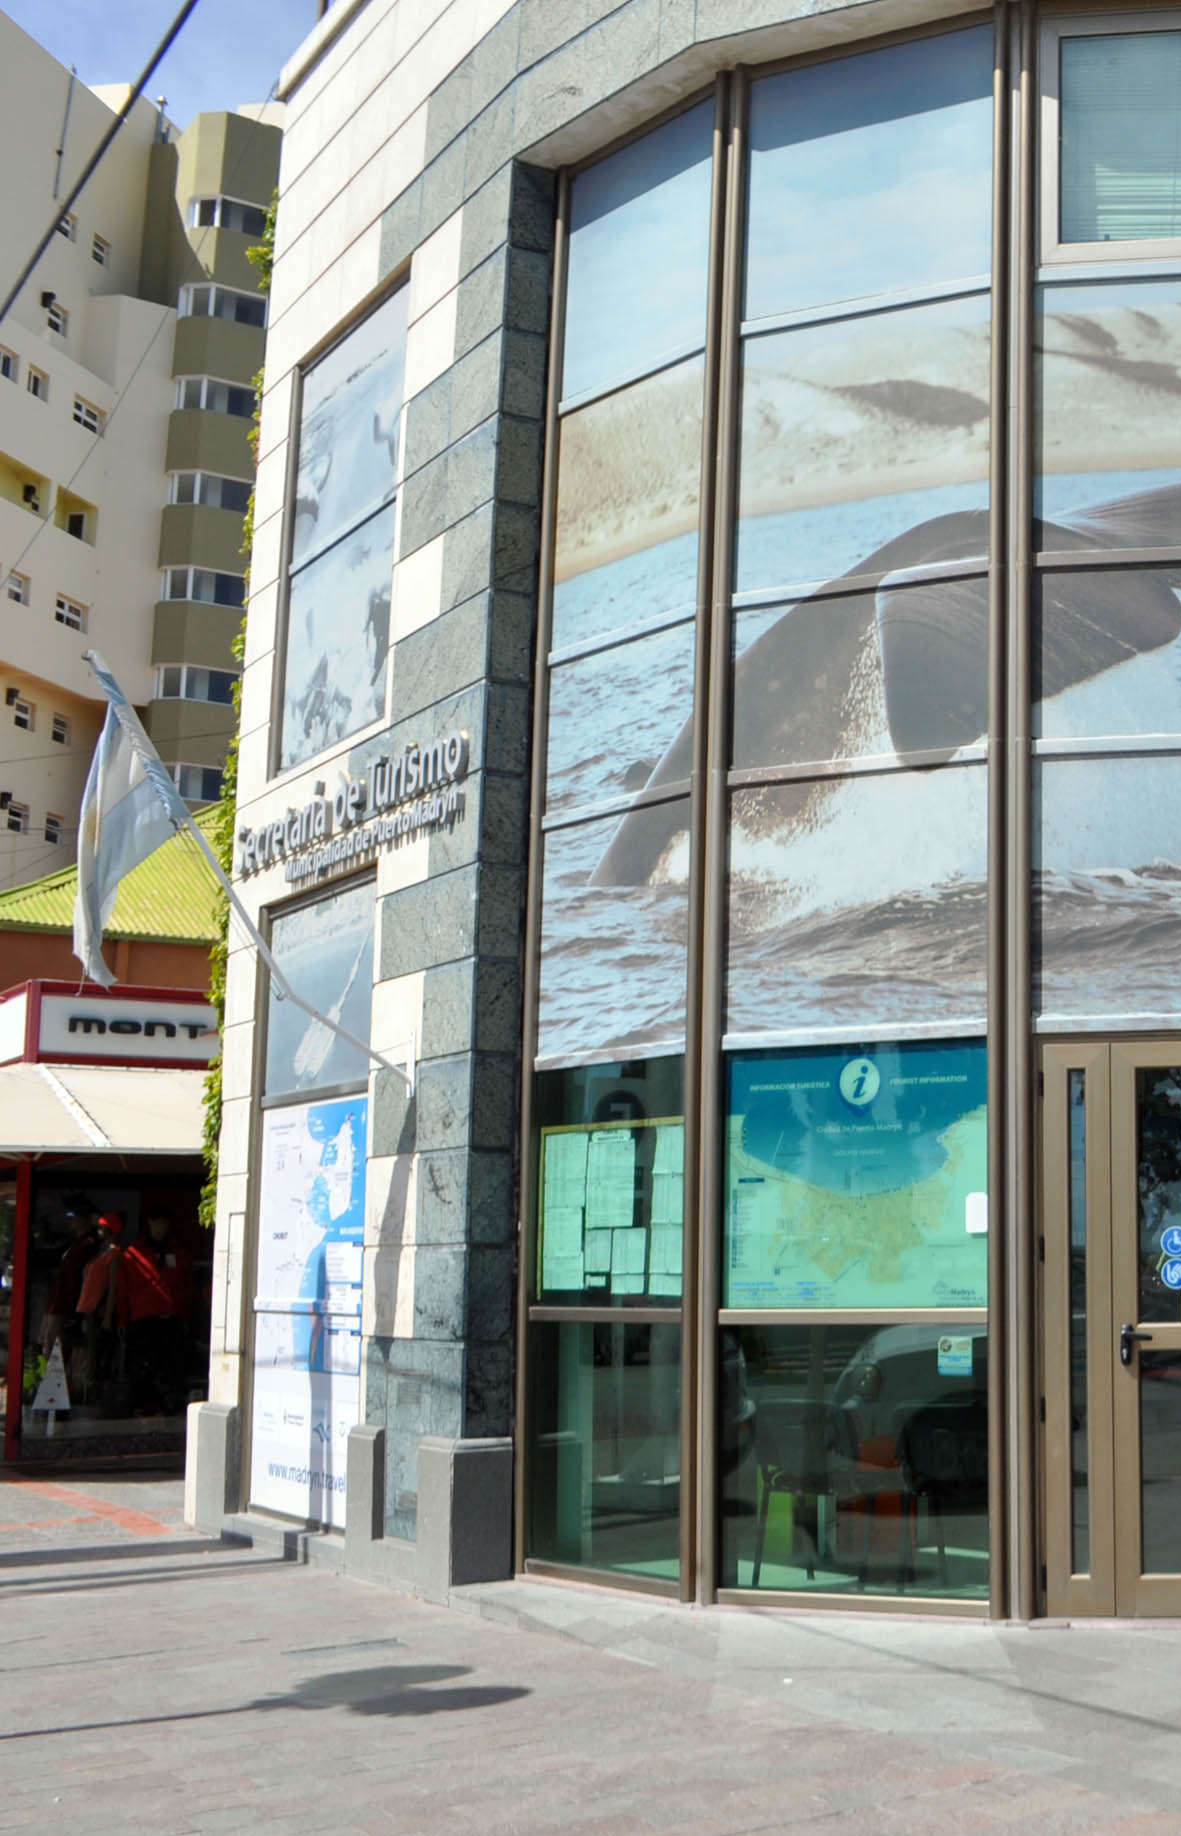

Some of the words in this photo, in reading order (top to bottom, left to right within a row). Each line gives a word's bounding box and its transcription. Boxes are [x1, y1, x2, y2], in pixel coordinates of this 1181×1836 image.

[333, 770, 360, 829] de
[367, 730, 463, 817] Turismo
[284, 834, 355, 881] Municipalidad
[355, 831, 371, 853] de
[370, 811, 410, 845] Puerto
[410, 790, 459, 823] Madryn
